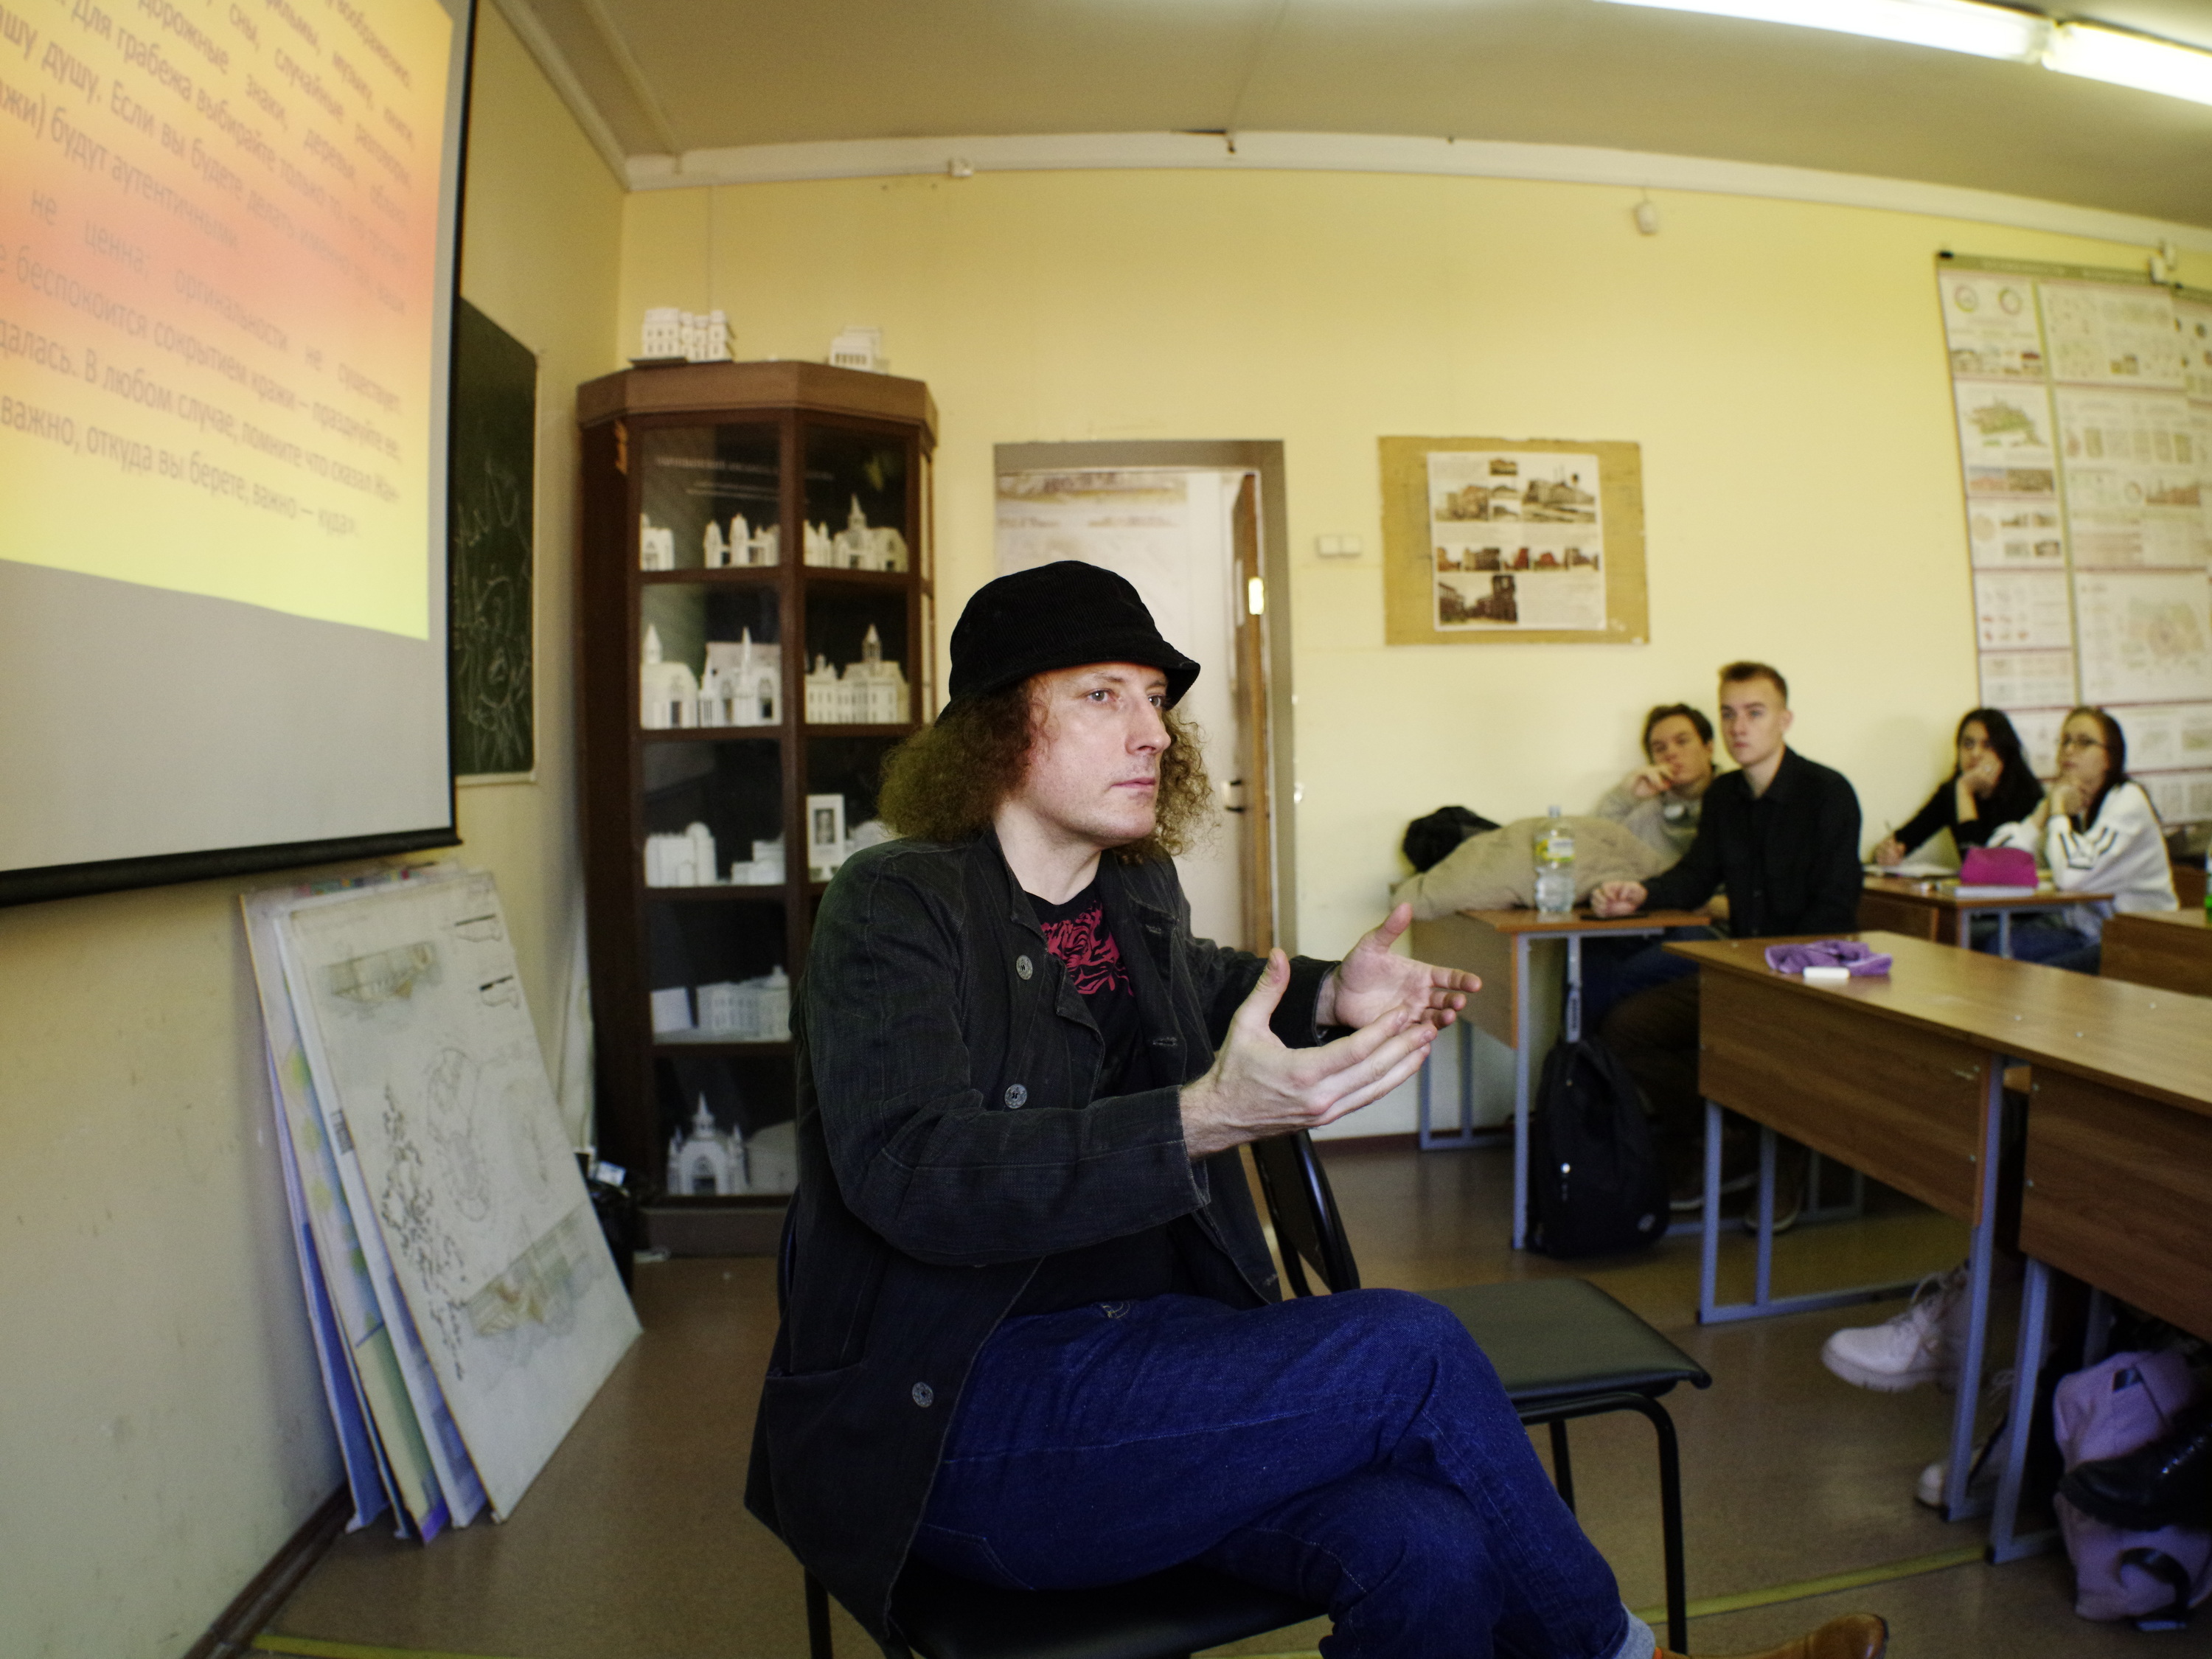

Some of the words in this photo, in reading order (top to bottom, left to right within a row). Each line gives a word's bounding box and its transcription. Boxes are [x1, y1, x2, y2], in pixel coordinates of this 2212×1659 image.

[0, 77, 46, 140] жи)
[50, 105, 108, 173] будут
[0, 4, 38, 61] шу
[41, 40, 102, 105] душу.
[111, 78, 155, 139] Если
[160, 122, 186, 160] вы
[190, 136, 244, 203] будете
[246, 189, 296, 240] делать
[299, 227, 350, 276] именно
[71, 0, 112, 41] Для
[116, 27, 192, 102] грабежа
[195, 87, 276, 173] выбирайте
[30, 189, 57, 226] не
[174, 268, 288, 353] оригинальности
[305, 344, 322, 372] не
[85, 347, 97, 384] В
[102, 364, 173, 414] любом
[178, 394, 238, 445] случае,
[242, 421, 302, 470] помните
[251, 371, 295, 411] кражи
[1, 394, 80, 456] важно,
[86, 425, 153, 476] откуда
[159, 450, 186, 481] вы
[189, 450, 250, 503] берете,
[253, 482, 297, 520] важно
